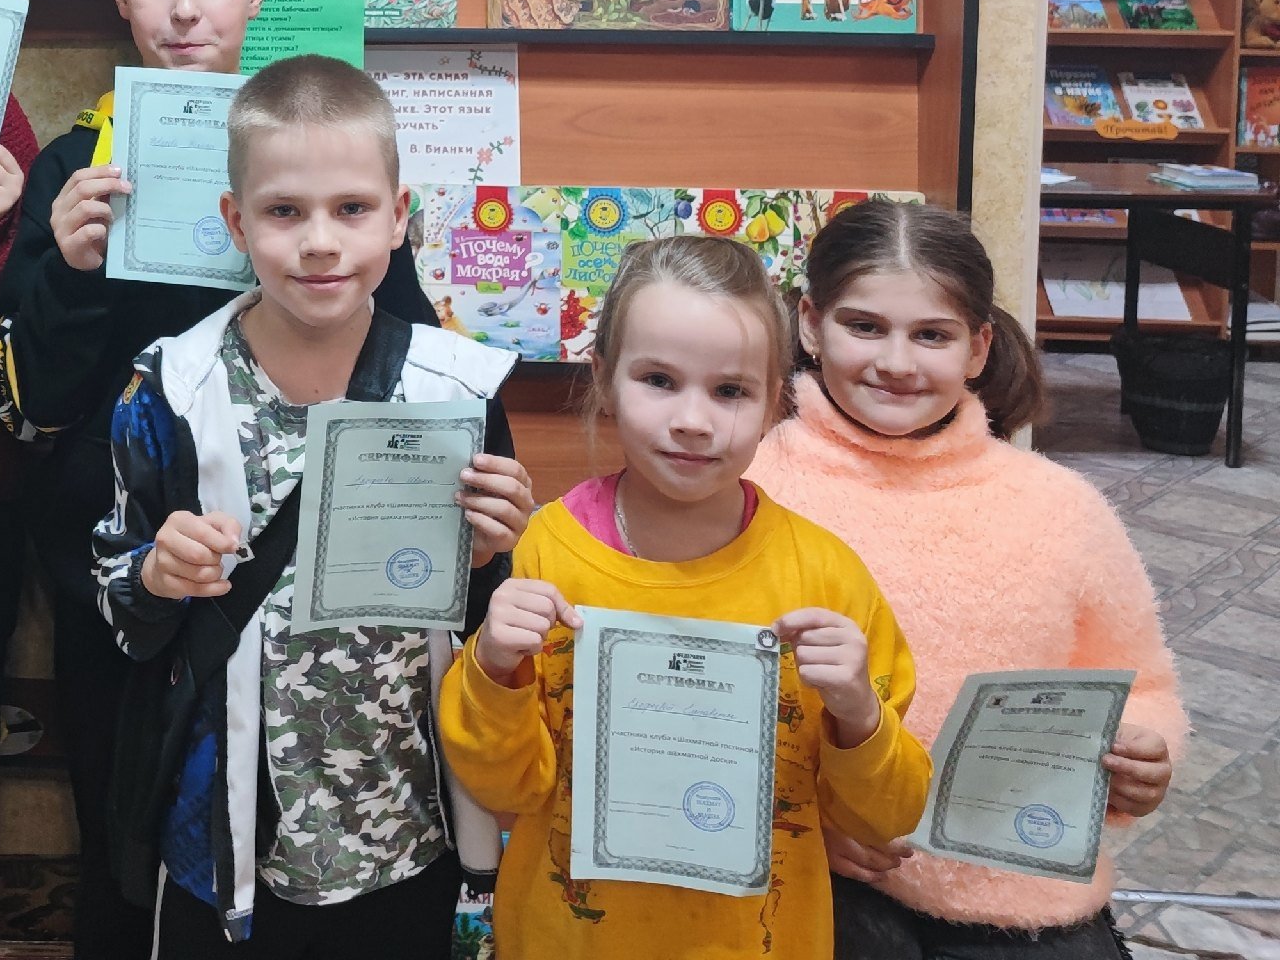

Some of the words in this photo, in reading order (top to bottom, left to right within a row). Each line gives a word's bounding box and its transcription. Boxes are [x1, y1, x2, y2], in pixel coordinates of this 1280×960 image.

[403, 72, 424, 81] ЭТА
[429, 72, 469, 81] САМАЯ
[413, 89, 493, 98] НАПИСАННАЯ
[424, 105, 453, 114] ЭТОТ
[458, 105, 492, 114] ЯЗЫК
[160, 116, 227, 129] СЕРТИФИКА
[410, 145, 421, 153] В.
[425, 145, 473, 154] БИАНКИ
[358, 453, 447, 464] СЕРТИФИКАТ
[637, 672, 735, 693] СЕРТИФИКАТ
[650, 734, 671, 742] клуба
[630, 746, 665, 754] «История
[667, 751, 708, 760] шахматной
